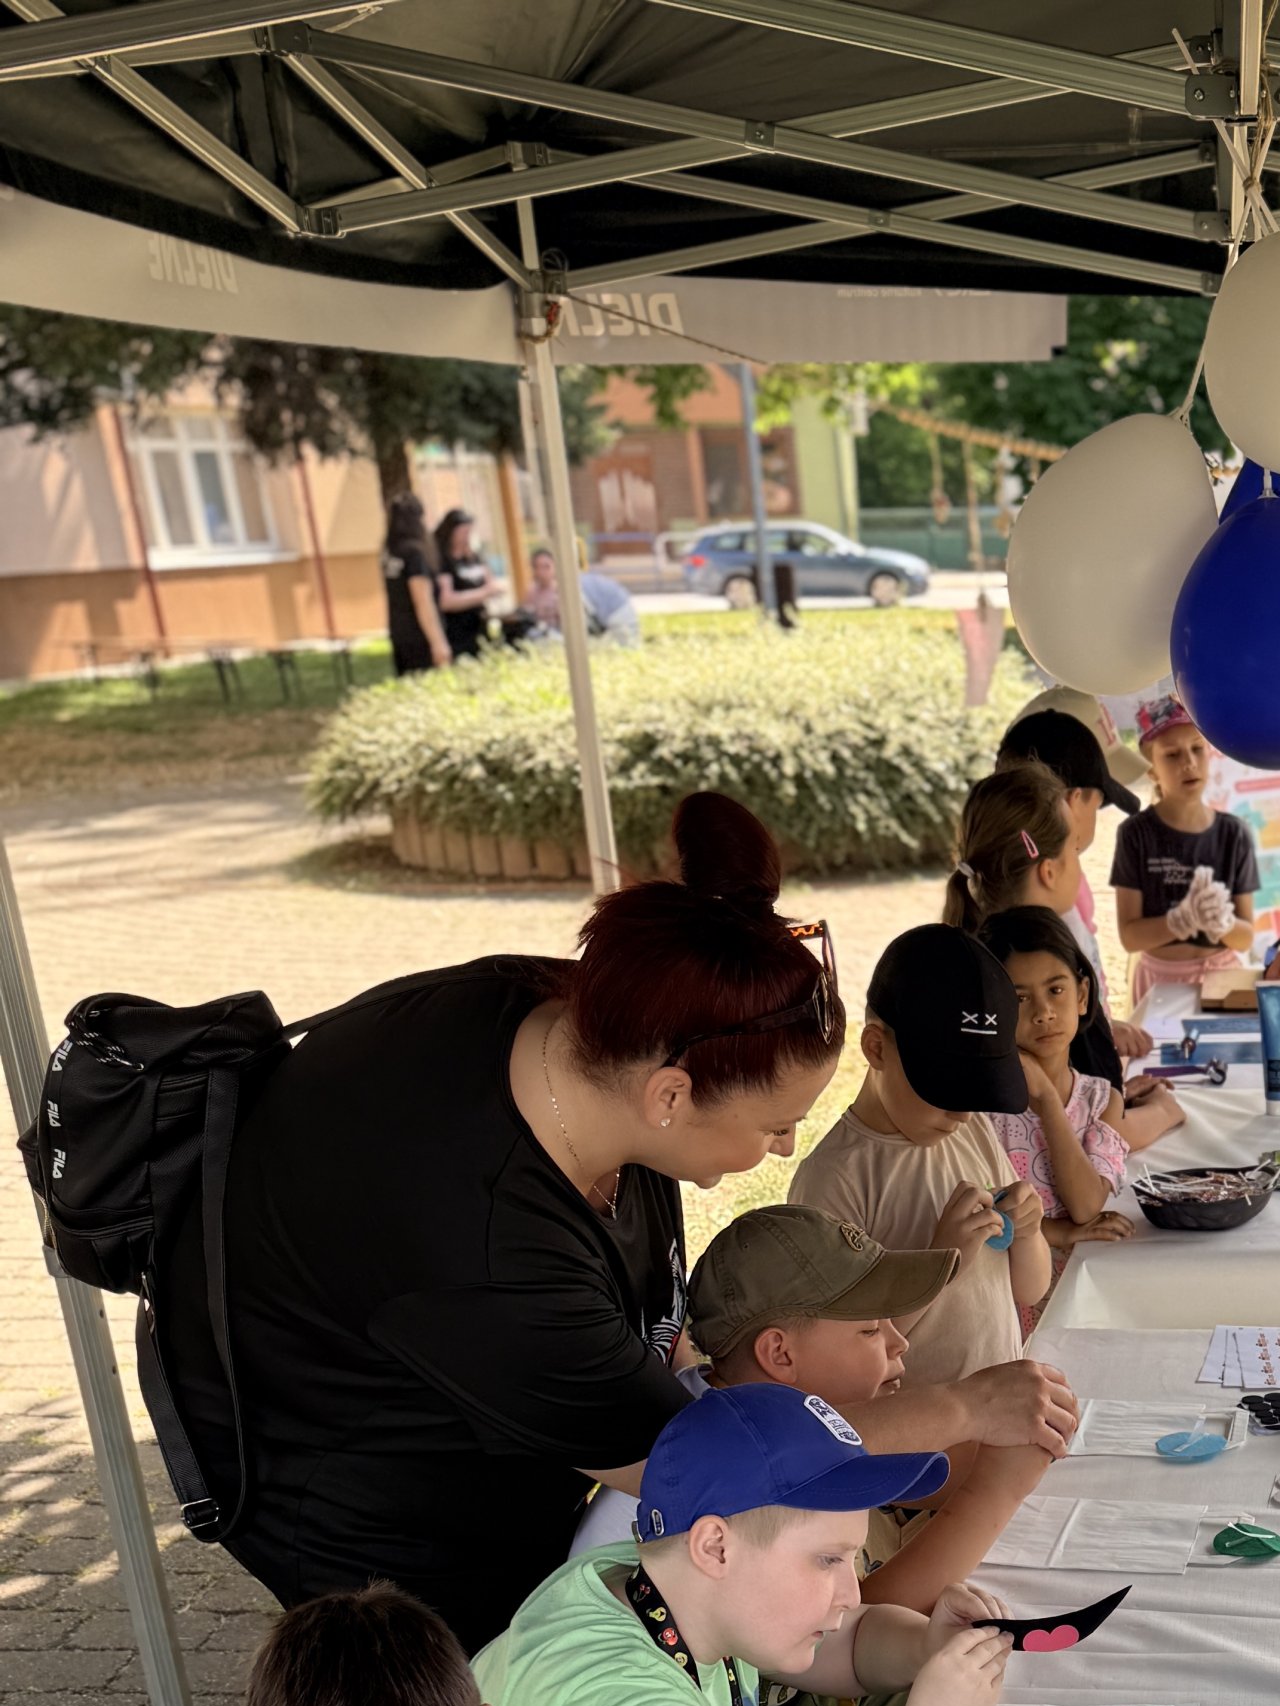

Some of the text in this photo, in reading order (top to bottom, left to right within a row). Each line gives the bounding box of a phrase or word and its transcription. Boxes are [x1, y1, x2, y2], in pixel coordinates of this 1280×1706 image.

[52, 1039, 71, 1073] FILA
[47, 1100, 61, 1128] FILA
[53, 1147, 66, 1180] FILA
